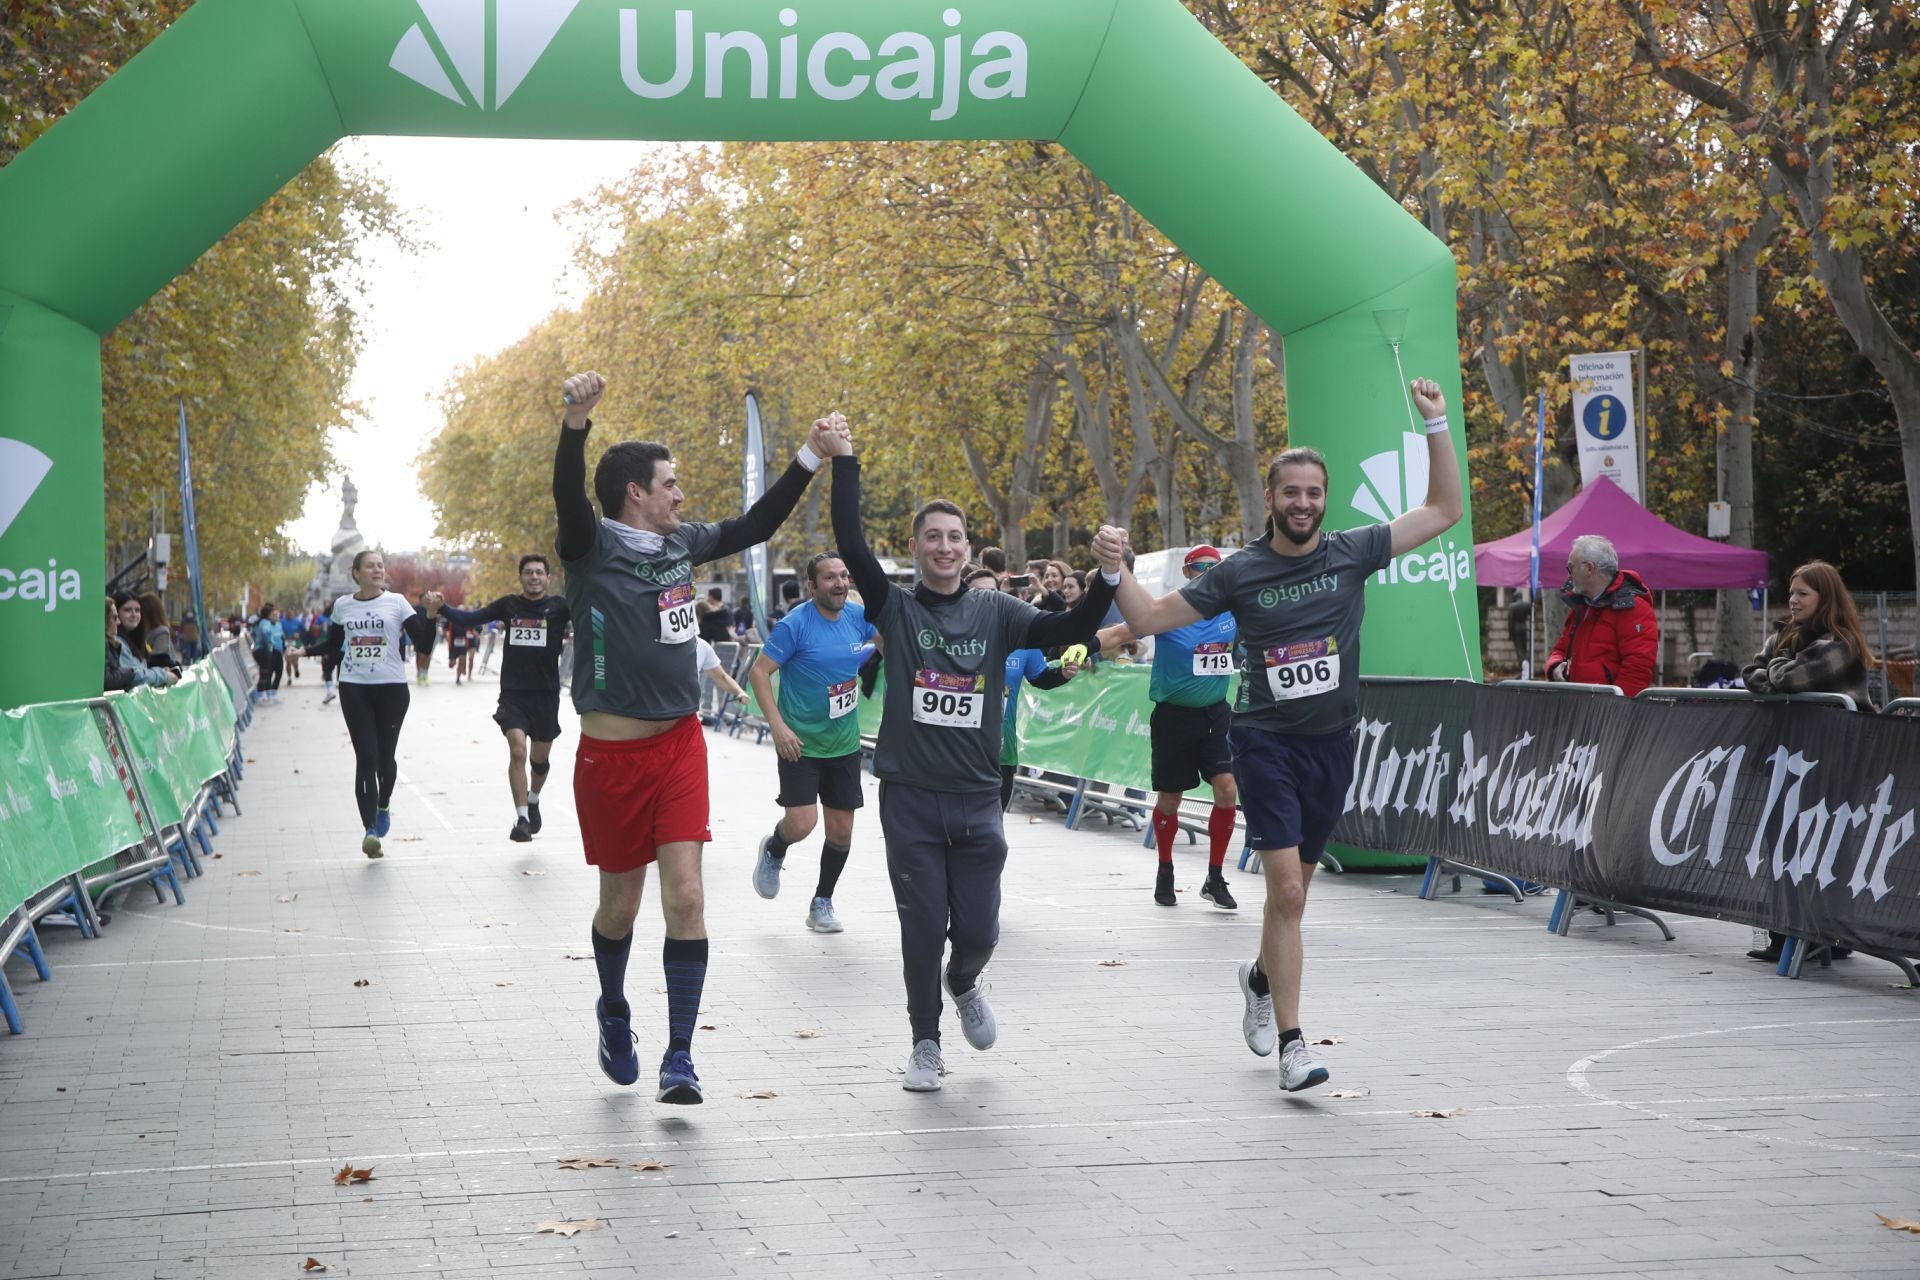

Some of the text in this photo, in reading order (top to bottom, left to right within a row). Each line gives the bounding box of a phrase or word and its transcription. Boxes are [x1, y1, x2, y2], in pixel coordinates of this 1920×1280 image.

[618, 7, 1028, 121] Unicaja
[1578, 362, 1615, 372] Oficina de
[0, 558, 81, 613] caja
[1257, 573, 1339, 609] Signify
[346, 619, 385, 631] curia
[515, 629, 541, 641] 233
[356, 647, 381, 658] 232
[1200, 655, 1228, 669] 119
[594, 654, 605, 680] RUN
[1277, 660, 1331, 689] 906
[836, 690, 857, 710] 120
[922, 691, 973, 717] 905
[1241, 680, 1251, 703] RUN
[1343, 716, 1449, 819] Norte
[1649, 744, 1915, 902] El Norte
